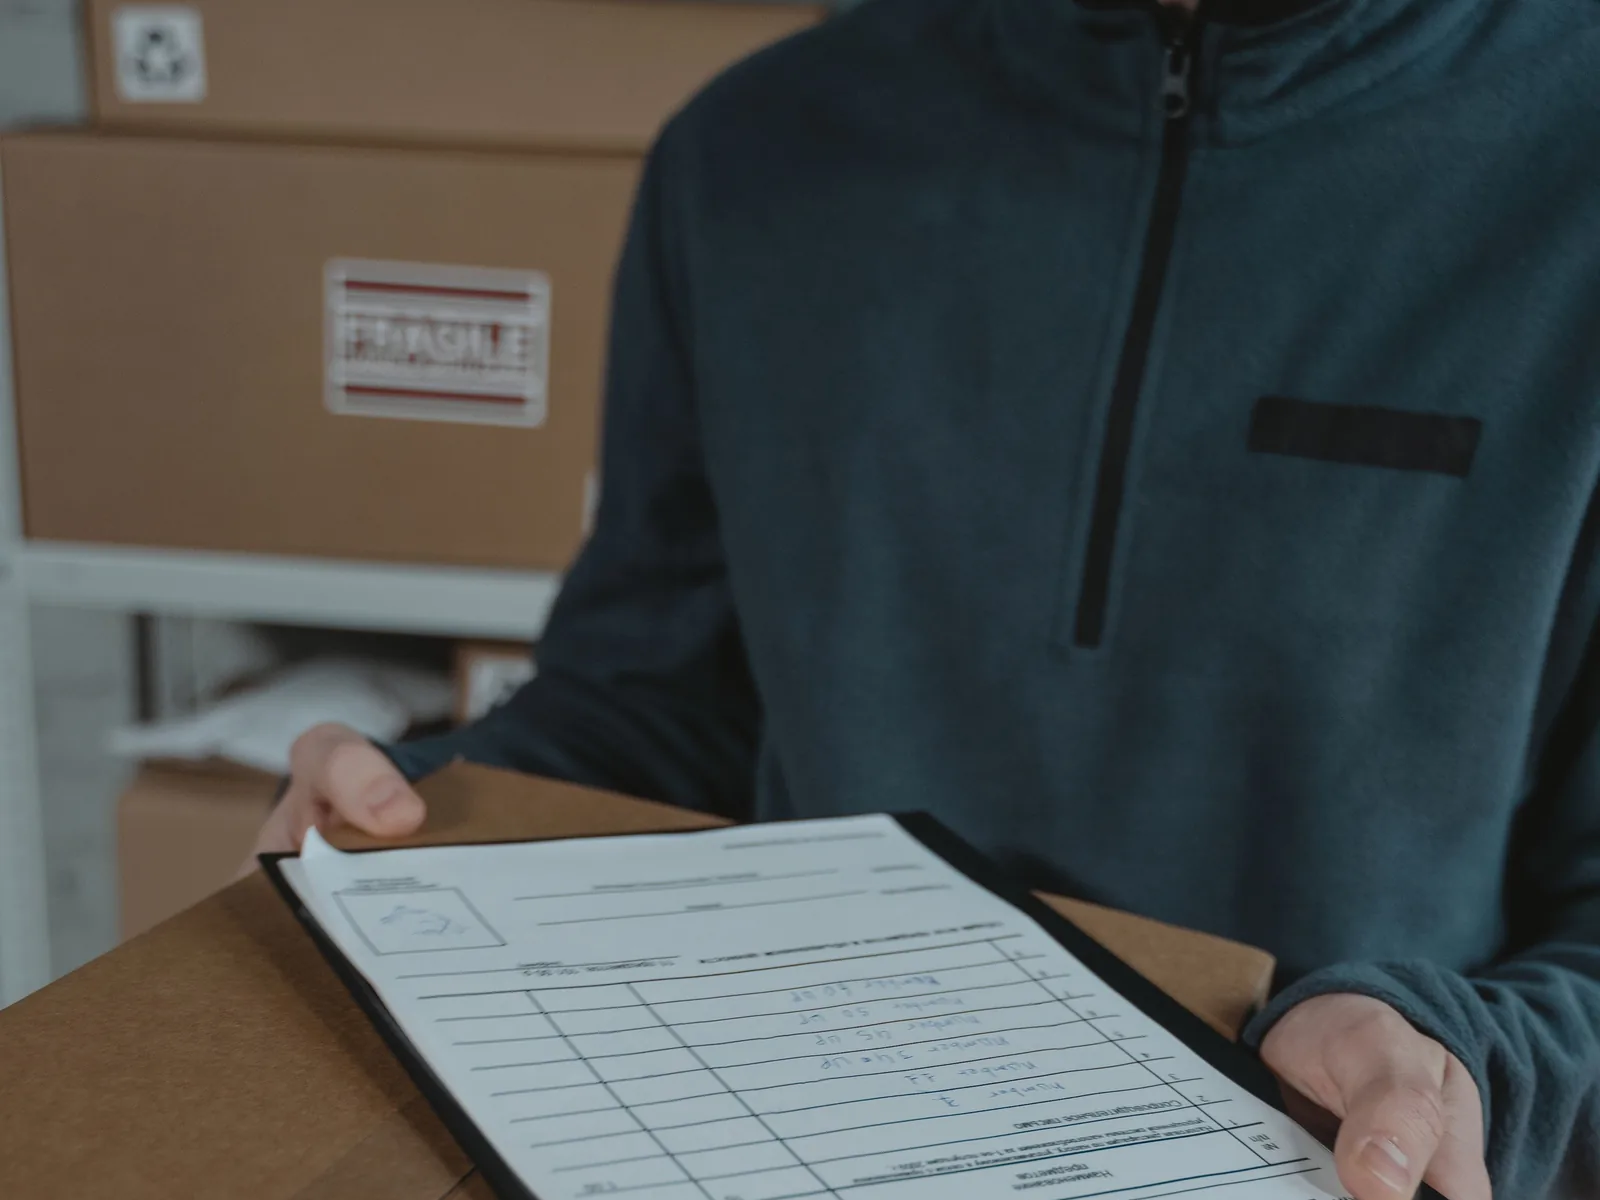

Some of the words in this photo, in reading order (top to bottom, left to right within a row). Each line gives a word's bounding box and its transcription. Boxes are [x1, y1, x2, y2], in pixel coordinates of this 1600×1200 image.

[1061, 1099, 1183, 1123] Сопроводительное
[1013, 1117, 1063, 1130] письмо
[1247, 1133, 1271, 1143] п/п
[1013, 1169, 1114, 1191] Наименование
[1015, 1163, 1090, 1180] предметов
